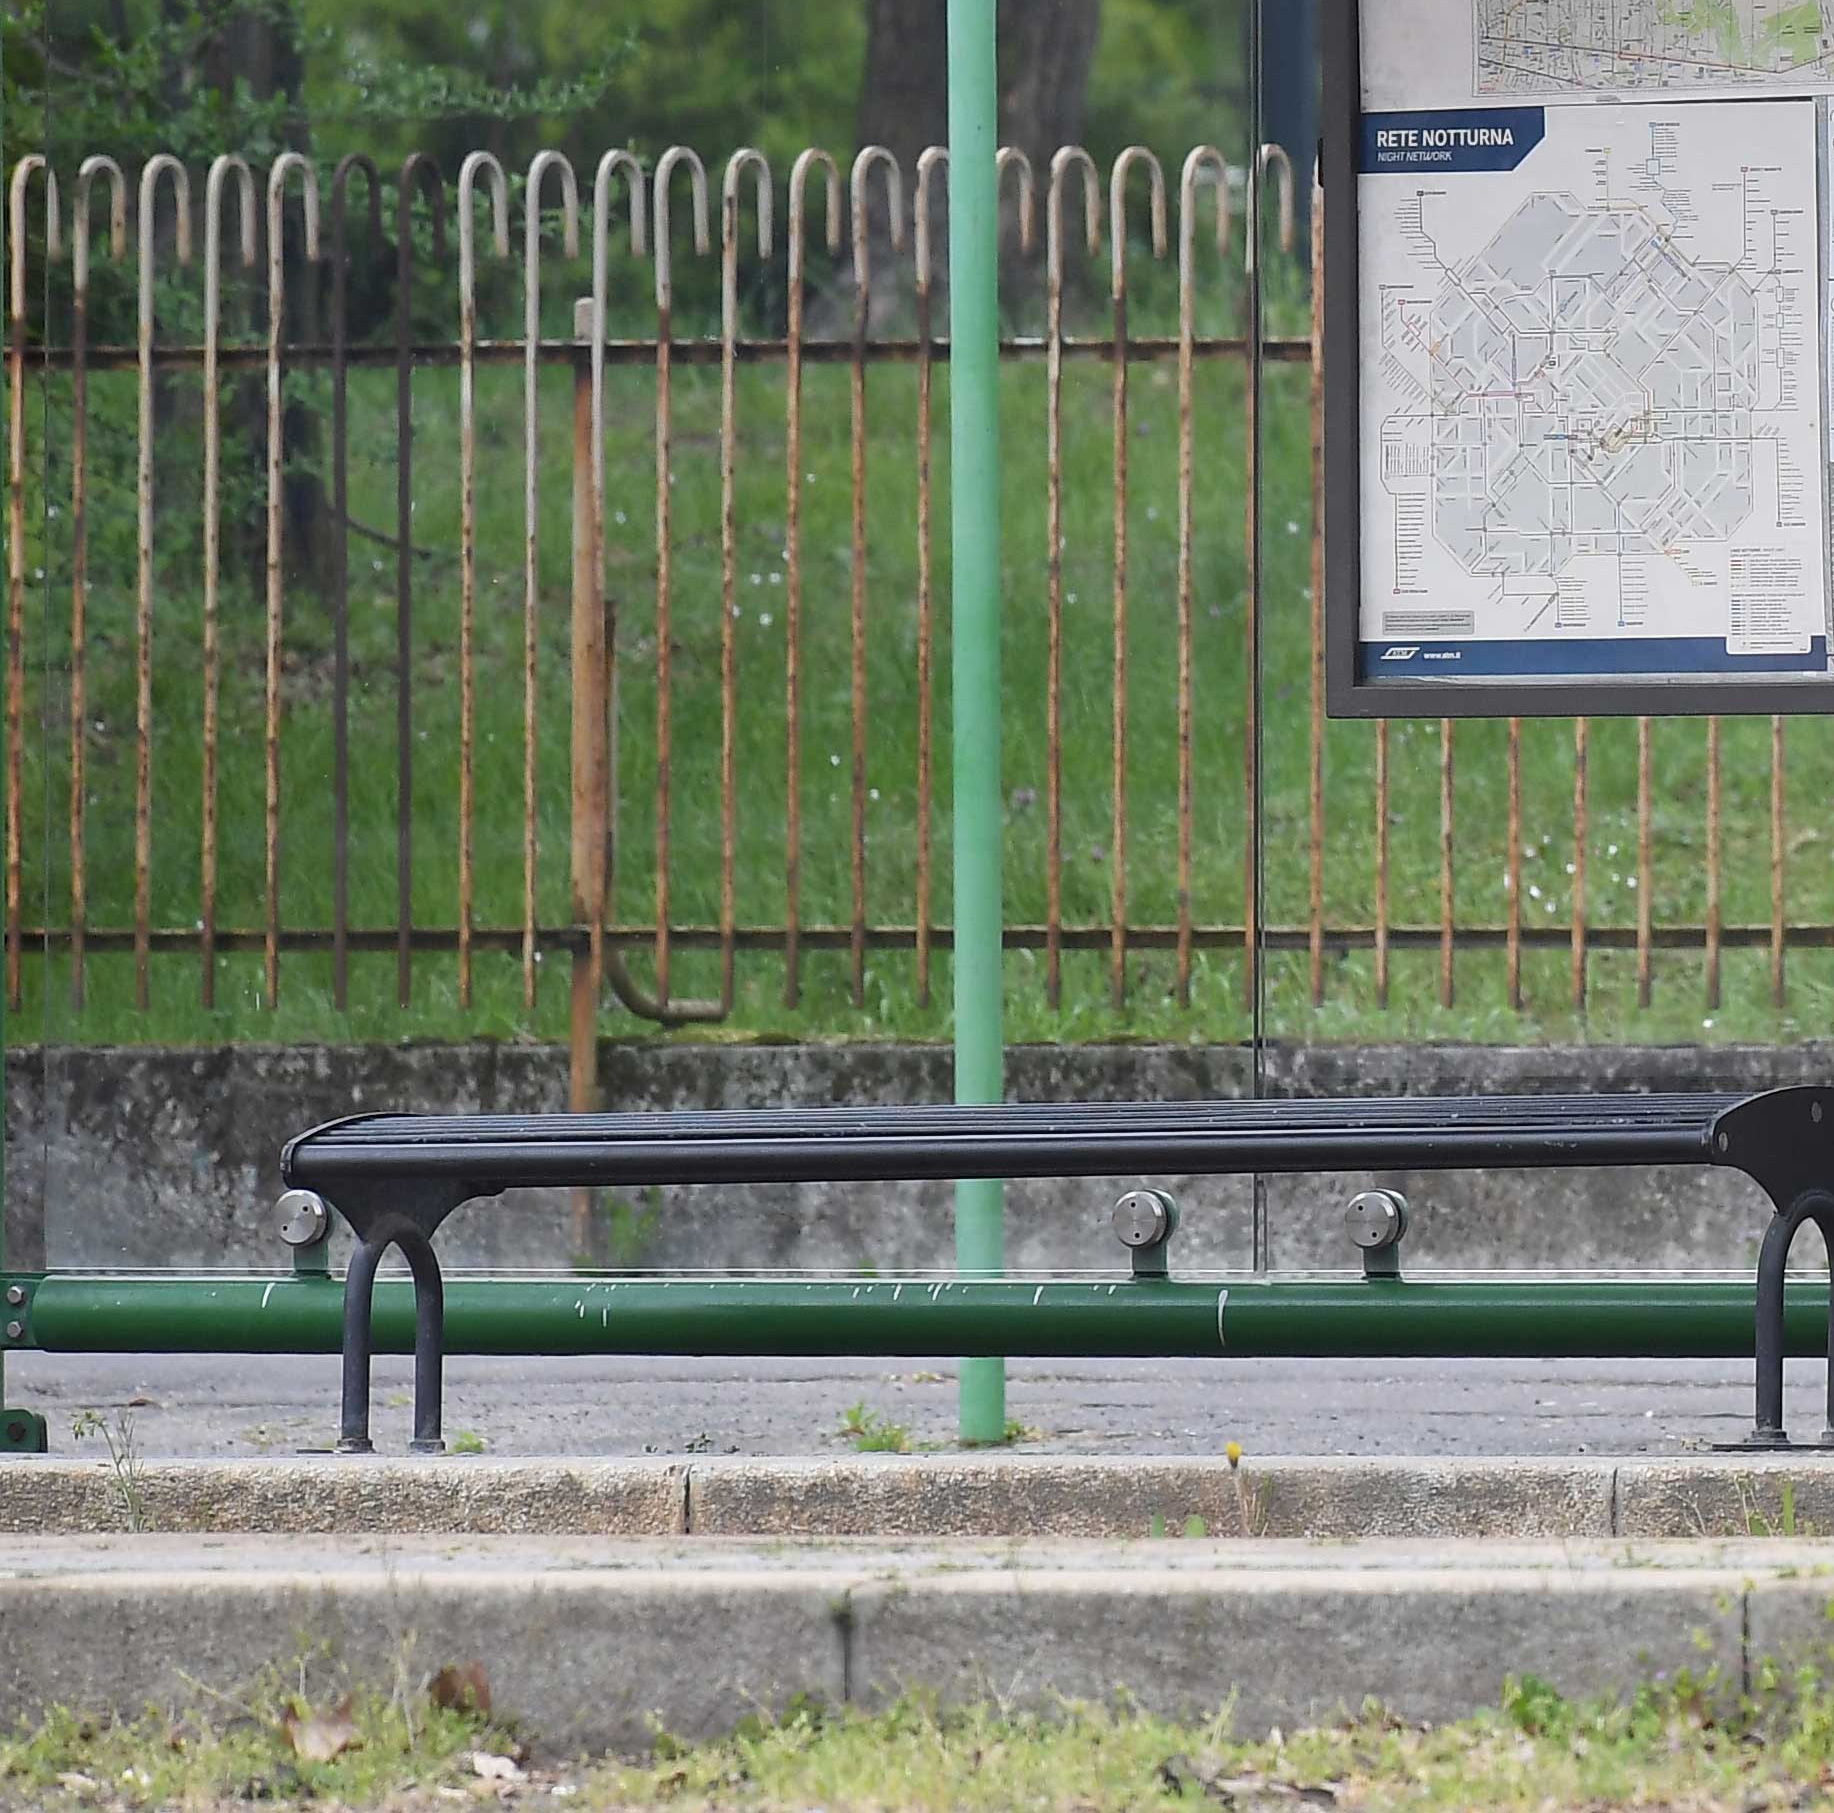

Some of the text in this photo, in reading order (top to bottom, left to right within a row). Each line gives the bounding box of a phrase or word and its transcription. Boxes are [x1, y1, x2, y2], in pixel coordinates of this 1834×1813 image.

[1376, 128, 1514, 148] RETE NOTTURNA
[1377, 150, 1453, 162] NIGHT NETWORK
